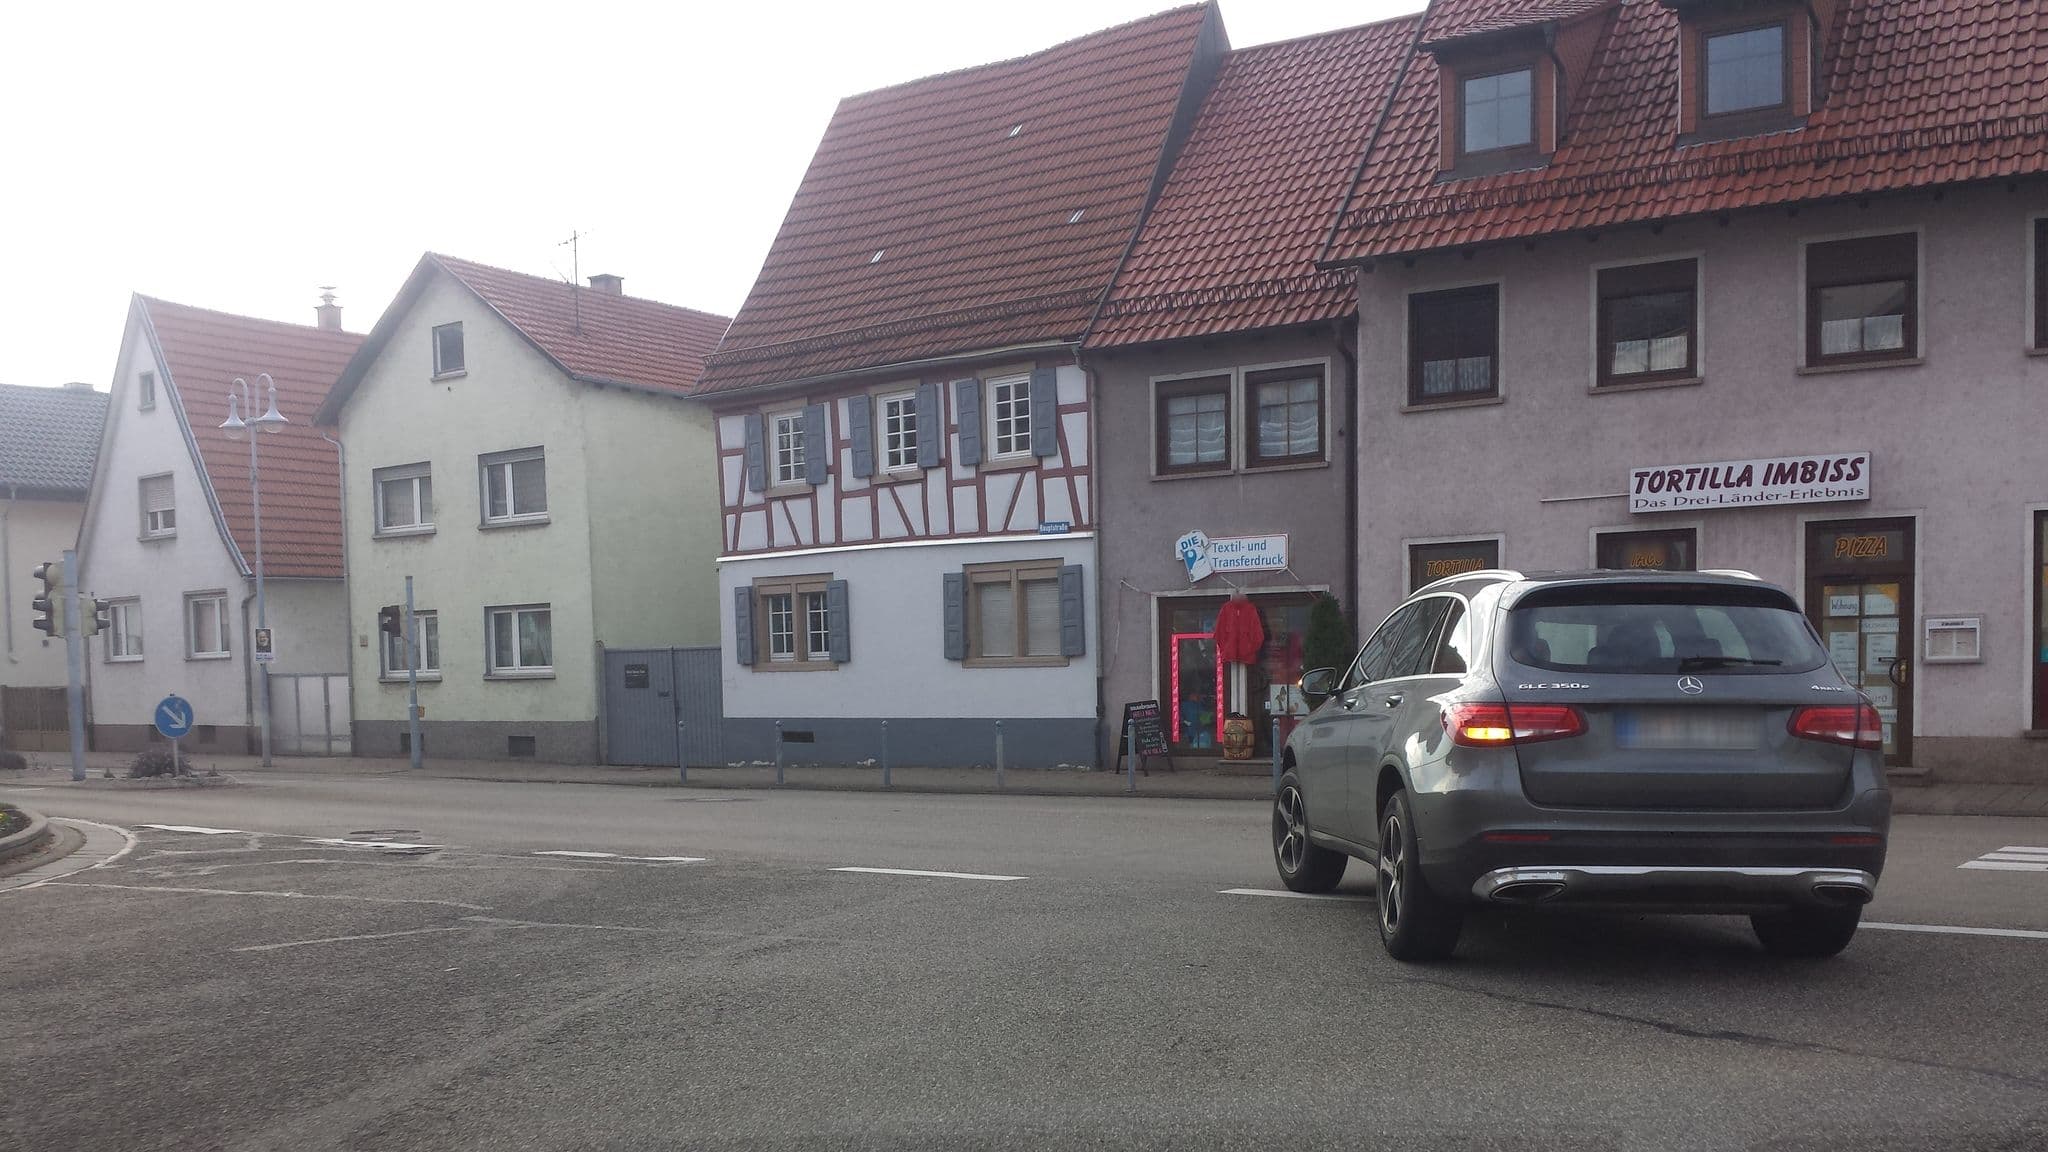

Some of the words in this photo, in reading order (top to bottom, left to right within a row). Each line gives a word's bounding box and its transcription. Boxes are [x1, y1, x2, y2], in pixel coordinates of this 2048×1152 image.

[1634, 464, 1753, 494] TORTILLA
[1762, 456, 1865, 486] IMBISS
[1635, 498, 1667, 509] Das
[1674, 487, 1865, 507] Drei-Länder-Erlebnis
[1180, 535, 1200, 551] DIE
[1212, 541, 1245, 553] Textil-
[1247, 540, 1267, 552] und
[1834, 535, 1888, 558] PIZZA
[1212, 554, 1284, 568] Transferdruck
